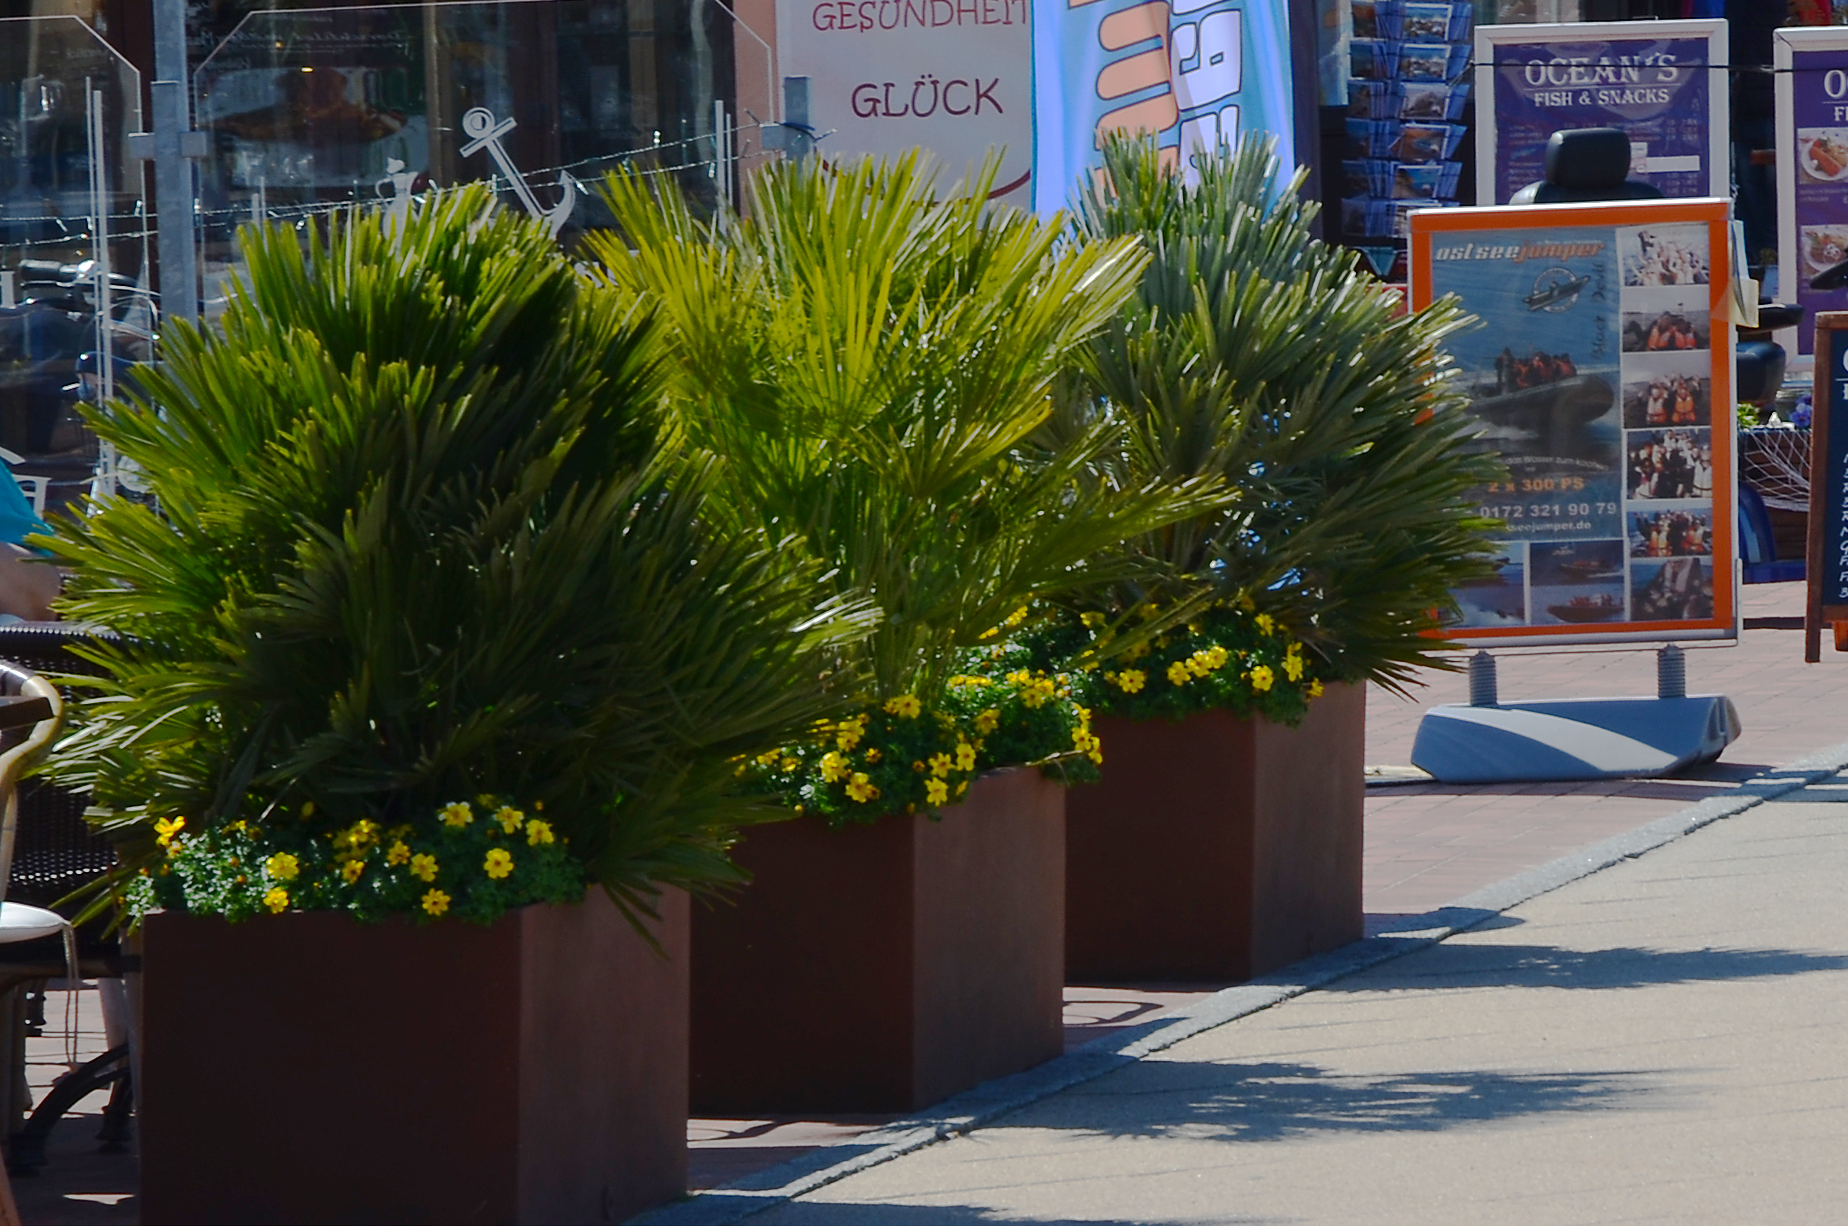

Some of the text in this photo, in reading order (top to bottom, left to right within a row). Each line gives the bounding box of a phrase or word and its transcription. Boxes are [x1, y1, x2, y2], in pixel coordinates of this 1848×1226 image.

[1525, 54, 1678, 86] OCEAN'S
[852, 74, 1003, 118] GLÜCK
[1535, 89, 1669, 107] FISH & SNACKS
[1488, 482, 1498, 493] 2
[1522, 479, 1553, 491] 300
[1561, 477, 1585, 490] PS
[1479, 502, 1617, 518] 0172 321 90 79
